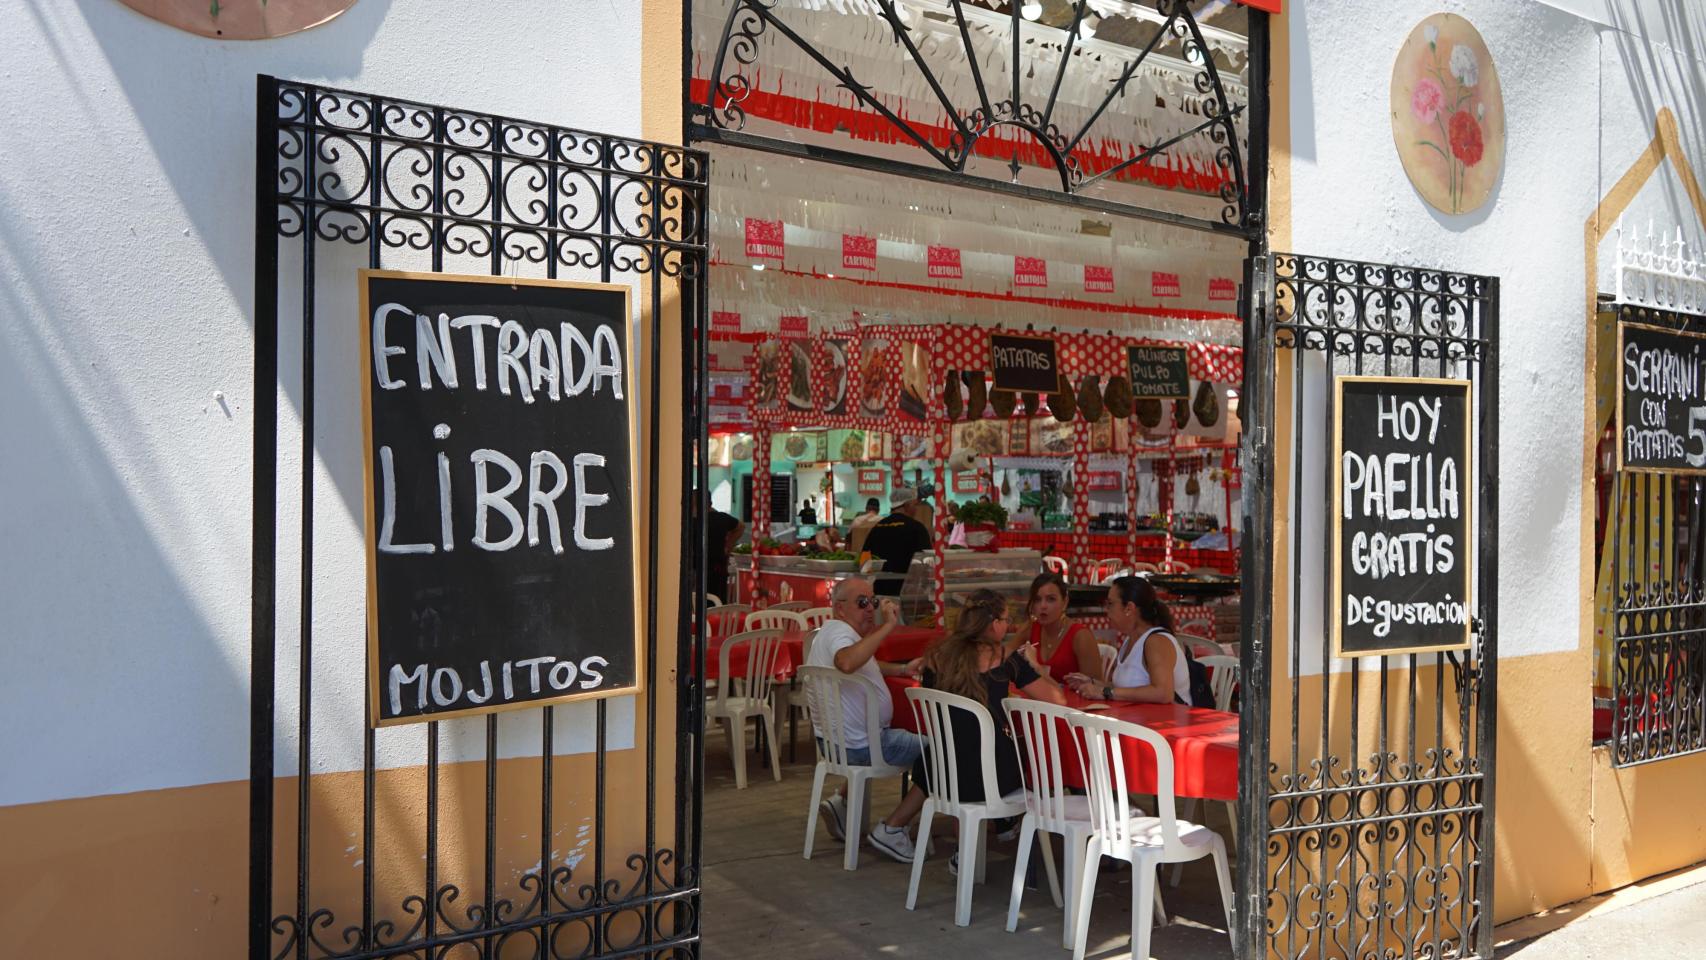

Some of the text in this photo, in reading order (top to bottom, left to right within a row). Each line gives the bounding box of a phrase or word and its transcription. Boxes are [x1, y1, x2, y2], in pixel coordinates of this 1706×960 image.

[746, 243, 784, 257] CARTOJAL
[843, 255, 876, 269] CARTOJAL
[928, 265, 962, 277] CARTOJAL
[1015, 274, 1047, 286] CARTOJAL
[1085, 281, 1115, 292] CARTOJAL
[1152, 286, 1181, 297] CARTOJAL
[373, 302, 624, 404] ENTRADA
[993, 345, 1049, 370] PATATAS
[1132, 364, 1169, 380] PULPO
[1133, 381, 1181, 395] TOMATE
[1377, 394, 1442, 445] HOY
[1640, 397, 1666, 428] CON
[1624, 424, 1686, 464] PATATAS
[1343, 449, 1459, 520] PAELLA
[388, 655, 610, 715] MOJITOS
